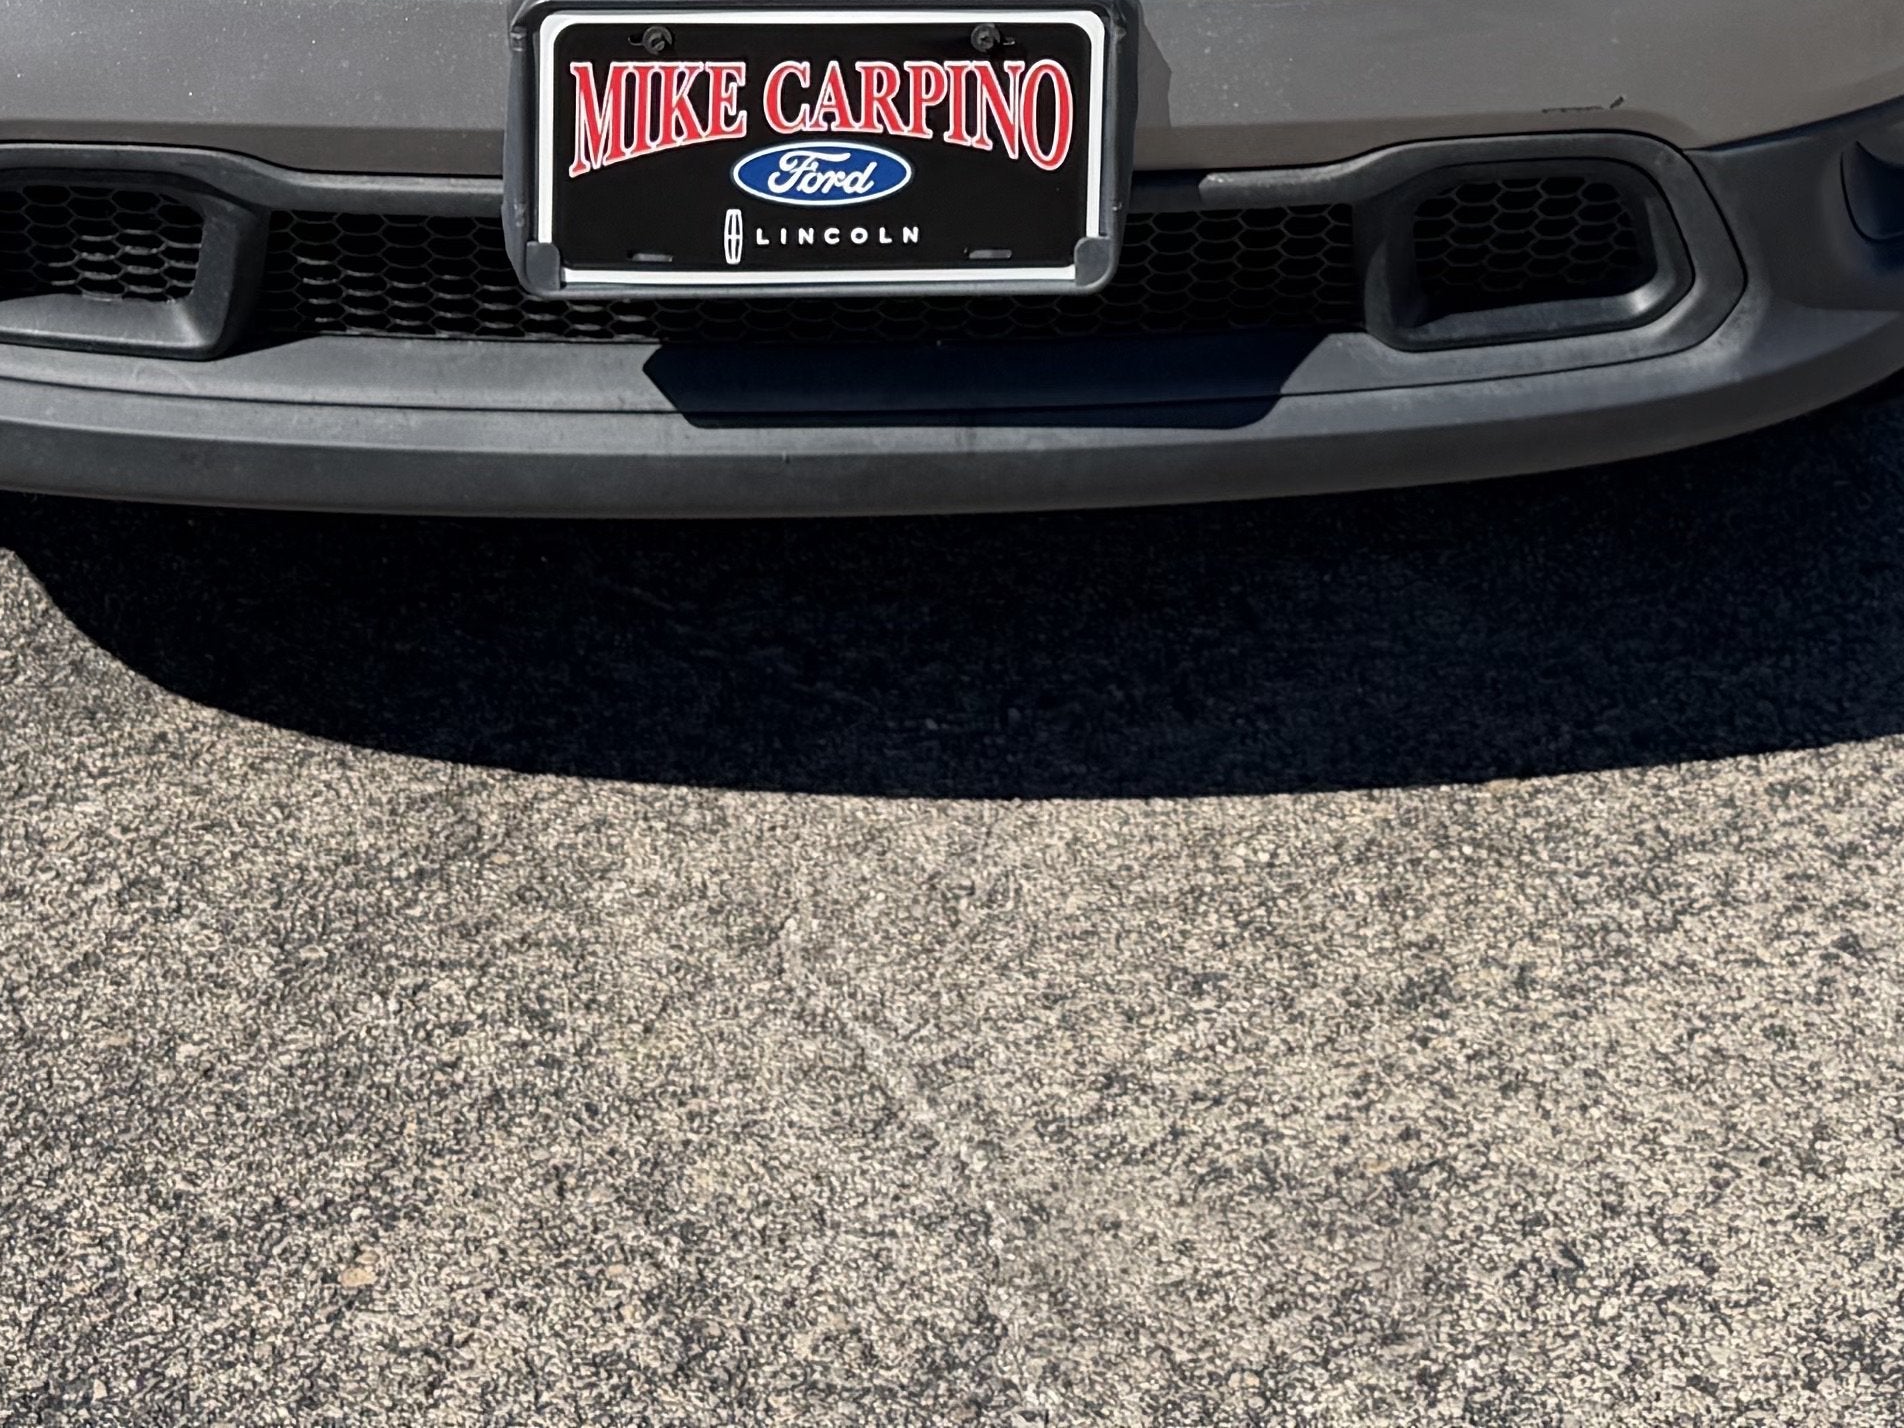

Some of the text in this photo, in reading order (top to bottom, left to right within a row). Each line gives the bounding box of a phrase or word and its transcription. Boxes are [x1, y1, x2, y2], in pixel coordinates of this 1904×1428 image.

[568, 58, 1074, 178] MIKE CARPINO
[767, 150, 876, 195] Ford
[755, 225, 920, 245] LINCOLN
